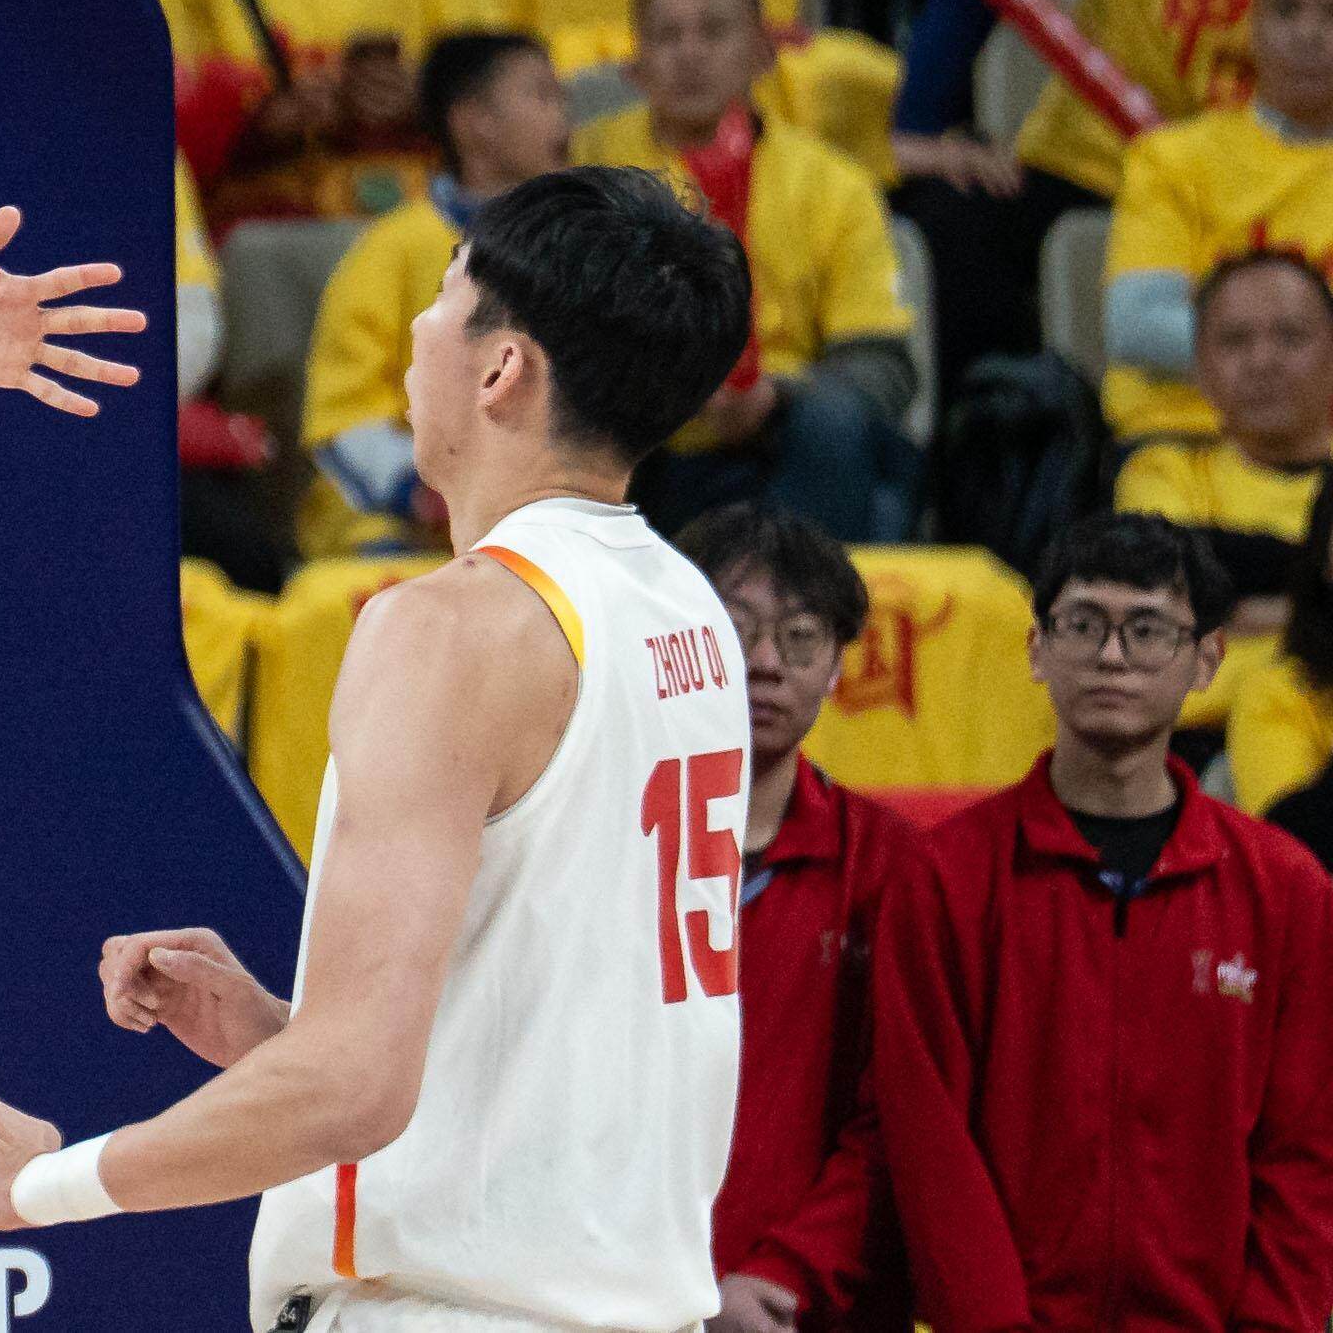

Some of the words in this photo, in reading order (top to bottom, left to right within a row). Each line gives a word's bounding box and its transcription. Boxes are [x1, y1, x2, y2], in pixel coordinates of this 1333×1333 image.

[645, 629, 704, 700] ZHOU
[702, 625, 730, 690] QI
[640, 747, 744, 1004] 15
